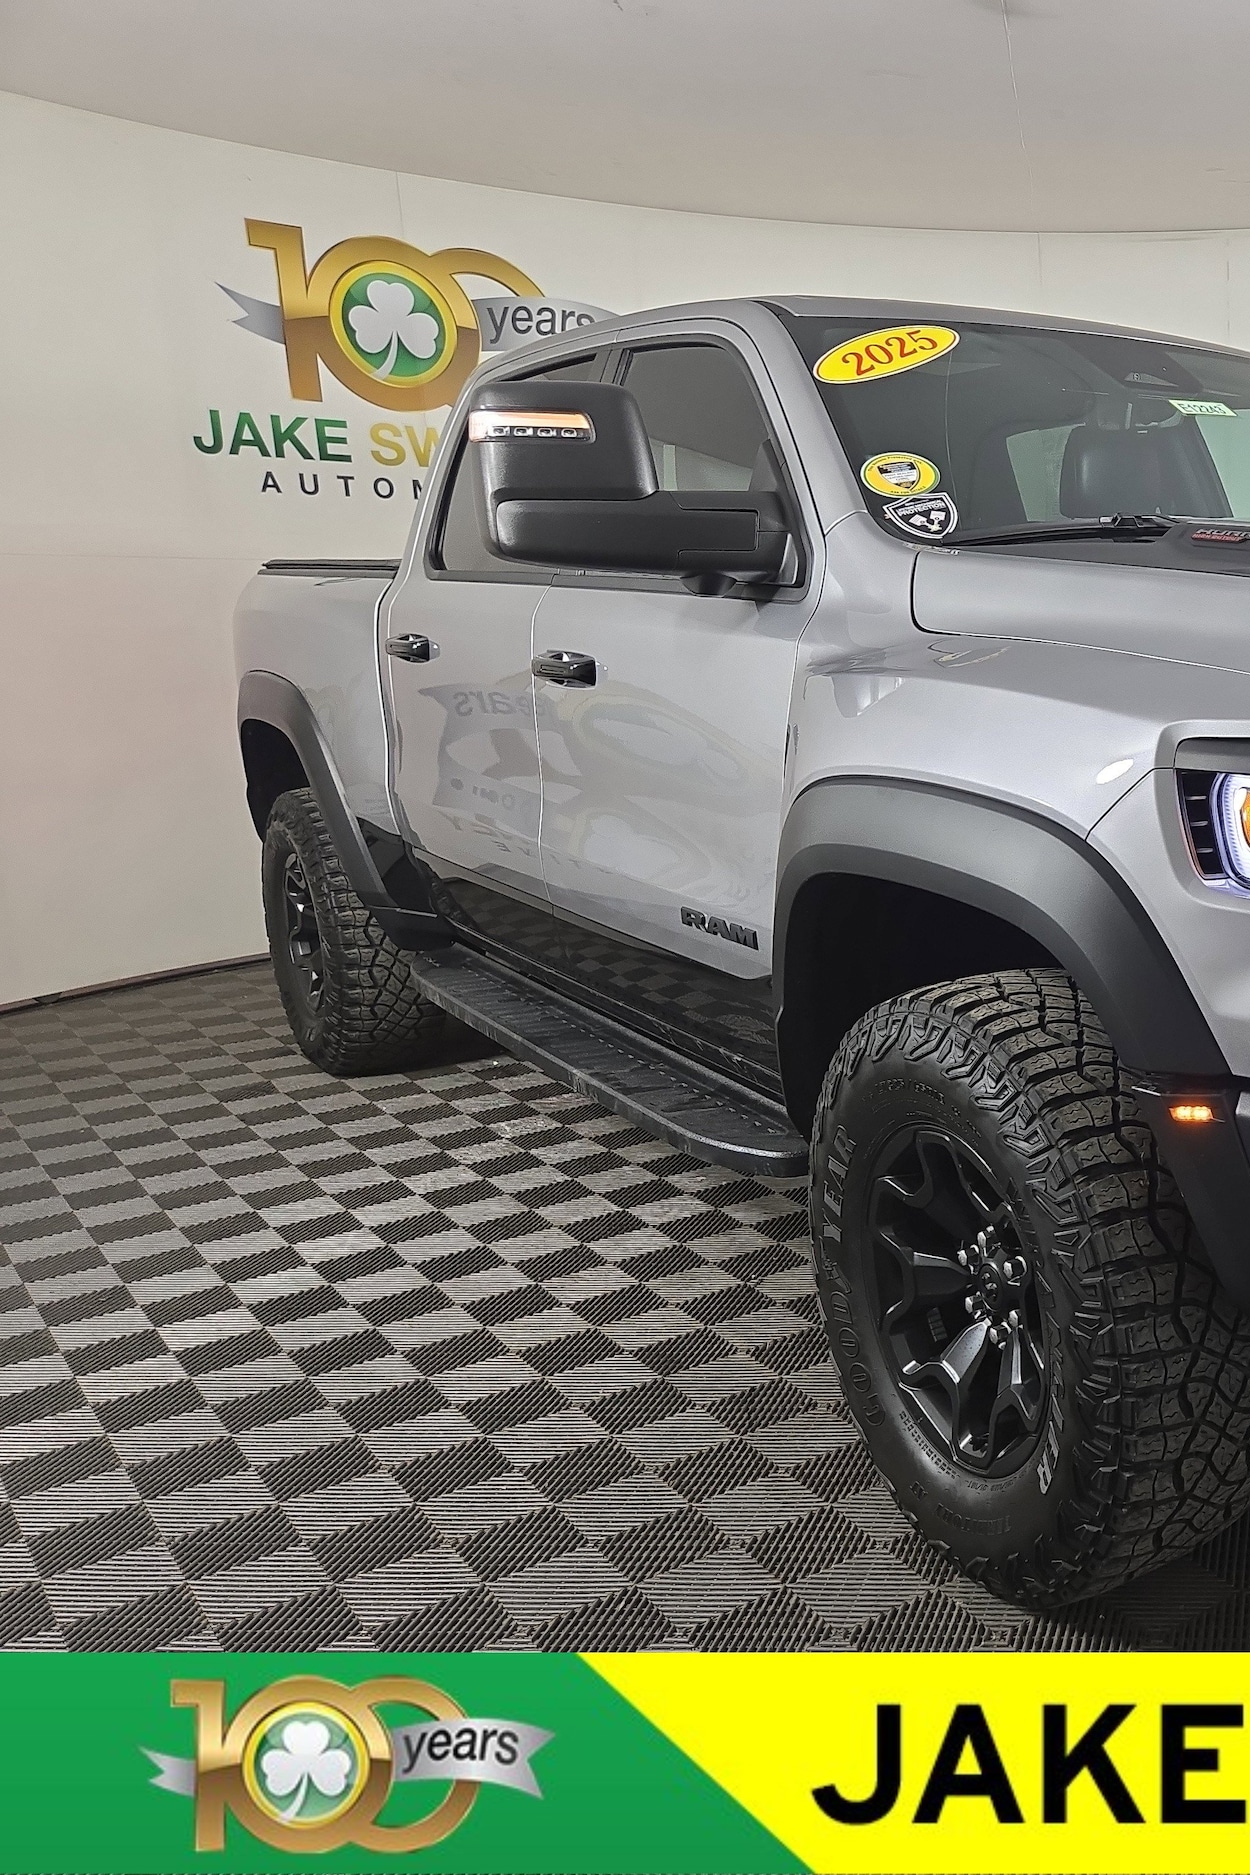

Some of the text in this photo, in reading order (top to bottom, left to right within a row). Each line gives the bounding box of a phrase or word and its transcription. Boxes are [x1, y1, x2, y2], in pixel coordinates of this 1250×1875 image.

[841, 330, 938, 376] 2025
[193, 409, 353, 463] JAKE
[681, 906, 759, 951] RAM
